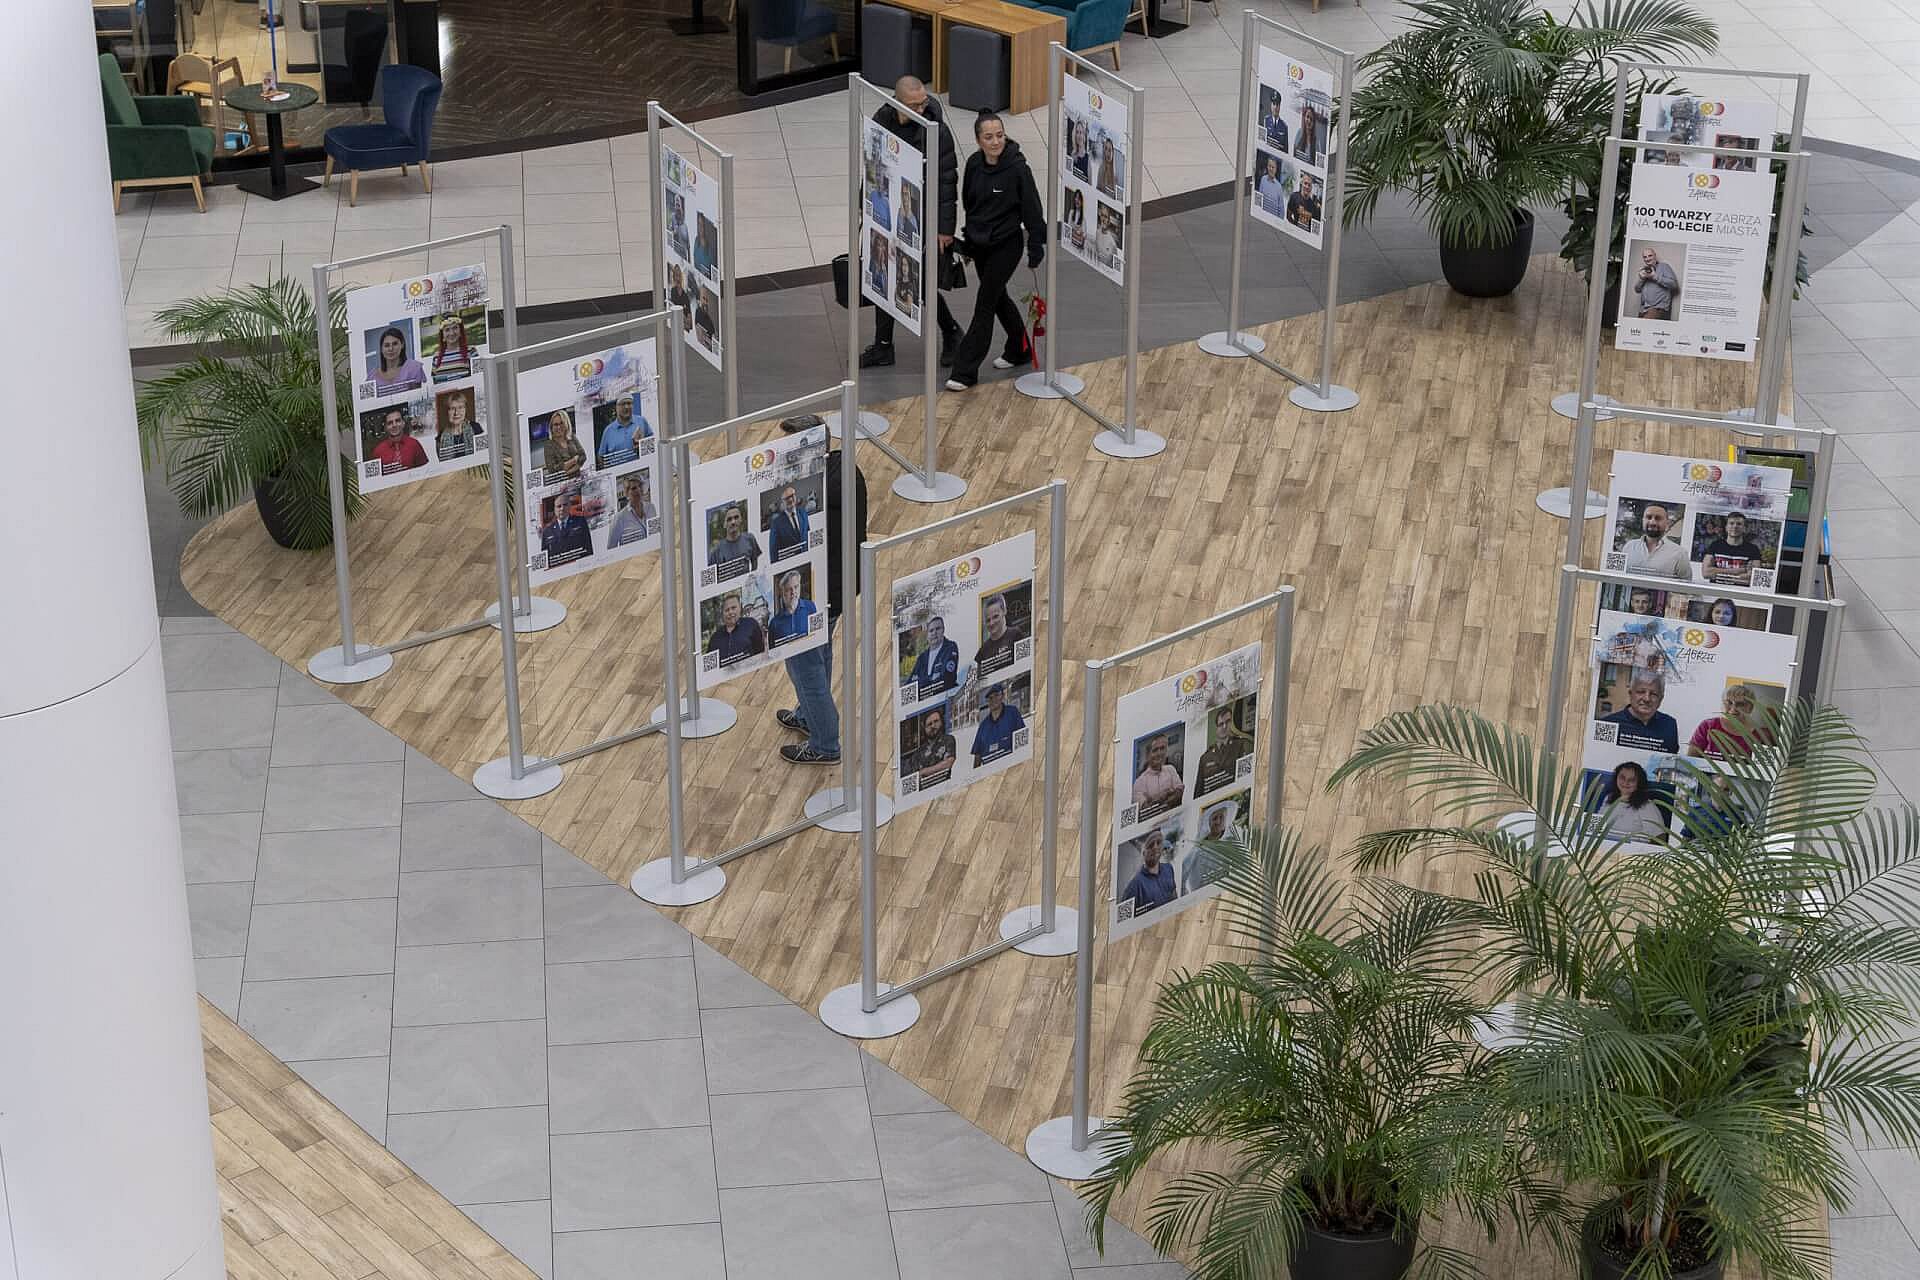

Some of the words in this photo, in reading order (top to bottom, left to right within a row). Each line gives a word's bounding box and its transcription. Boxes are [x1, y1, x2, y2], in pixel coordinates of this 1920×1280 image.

[1633, 206, 1656, 217] 100
[1659, 208, 1713, 222] TWARZY
[1714, 212, 1762, 226] ZABRZA
[1631, 217, 1650, 229] NA
[1653, 219, 1714, 233] 100-LECIE
[1715, 224, 1760, 237] MIASTA
